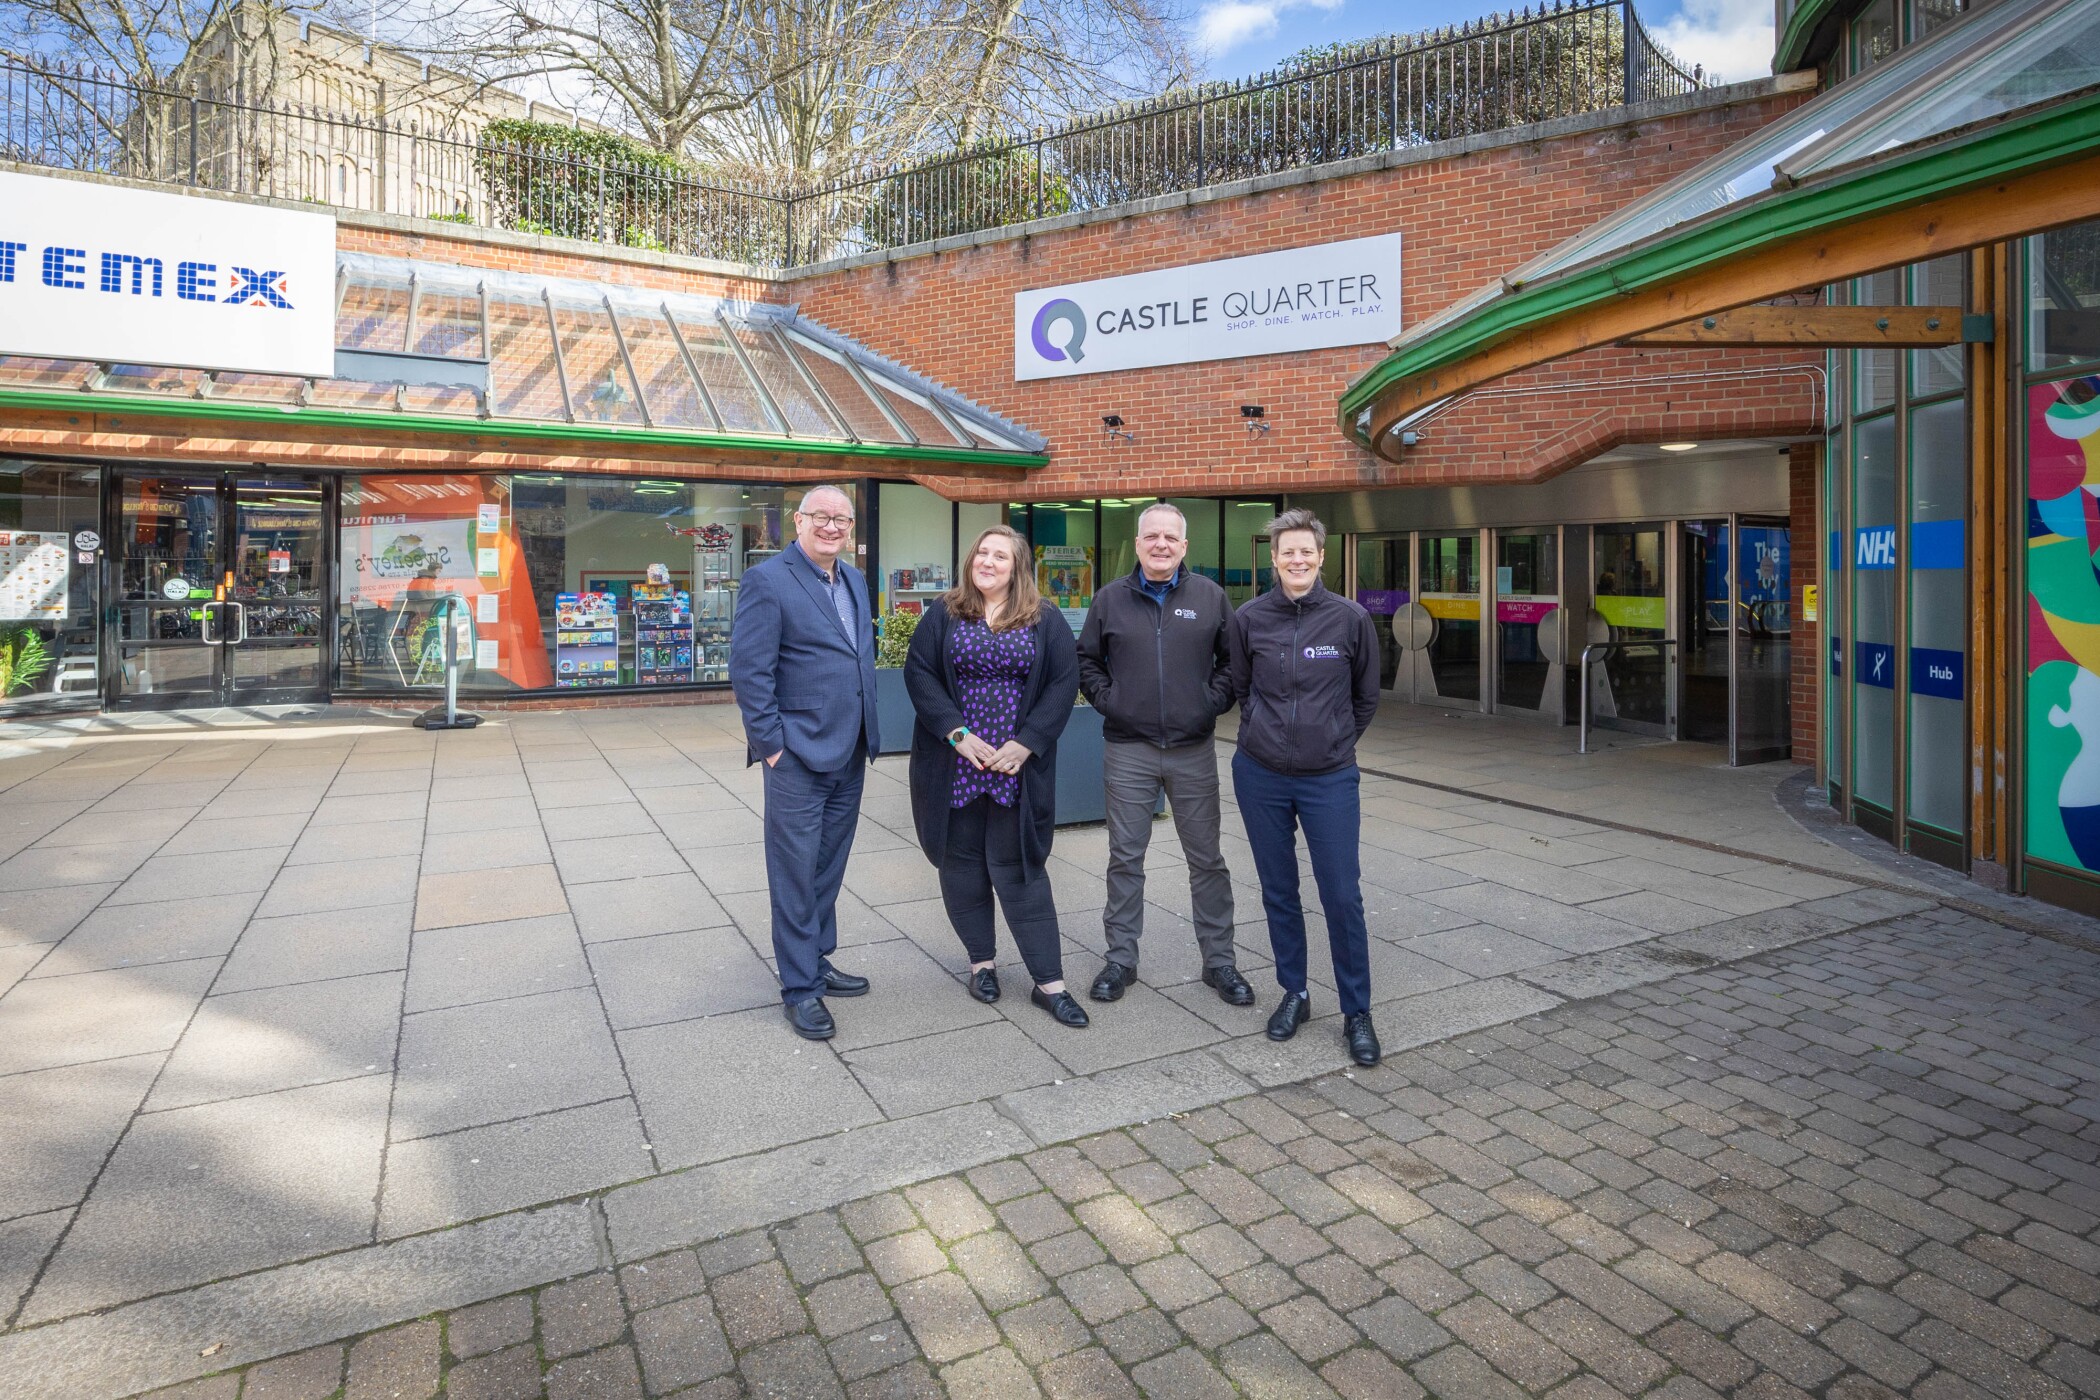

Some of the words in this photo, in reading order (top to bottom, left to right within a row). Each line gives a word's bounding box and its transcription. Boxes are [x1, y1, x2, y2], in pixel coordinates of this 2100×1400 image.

[1096, 297, 1208, 335] CASTLE
[1223, 274, 1382, 319] QUARTER
[1226, 319, 1258, 331] SHOP.
[1264, 315, 1293, 326] DINE.
[1301, 309, 1344, 322] WATCH.
[1351, 304, 1384, 316] PLAY.
[1046, 547, 1082, 555] STEMEX
[1754, 541, 1780, 563] The
[1507, 603, 1535, 612] WATCH.
[1929, 665, 1953, 681] Hub
